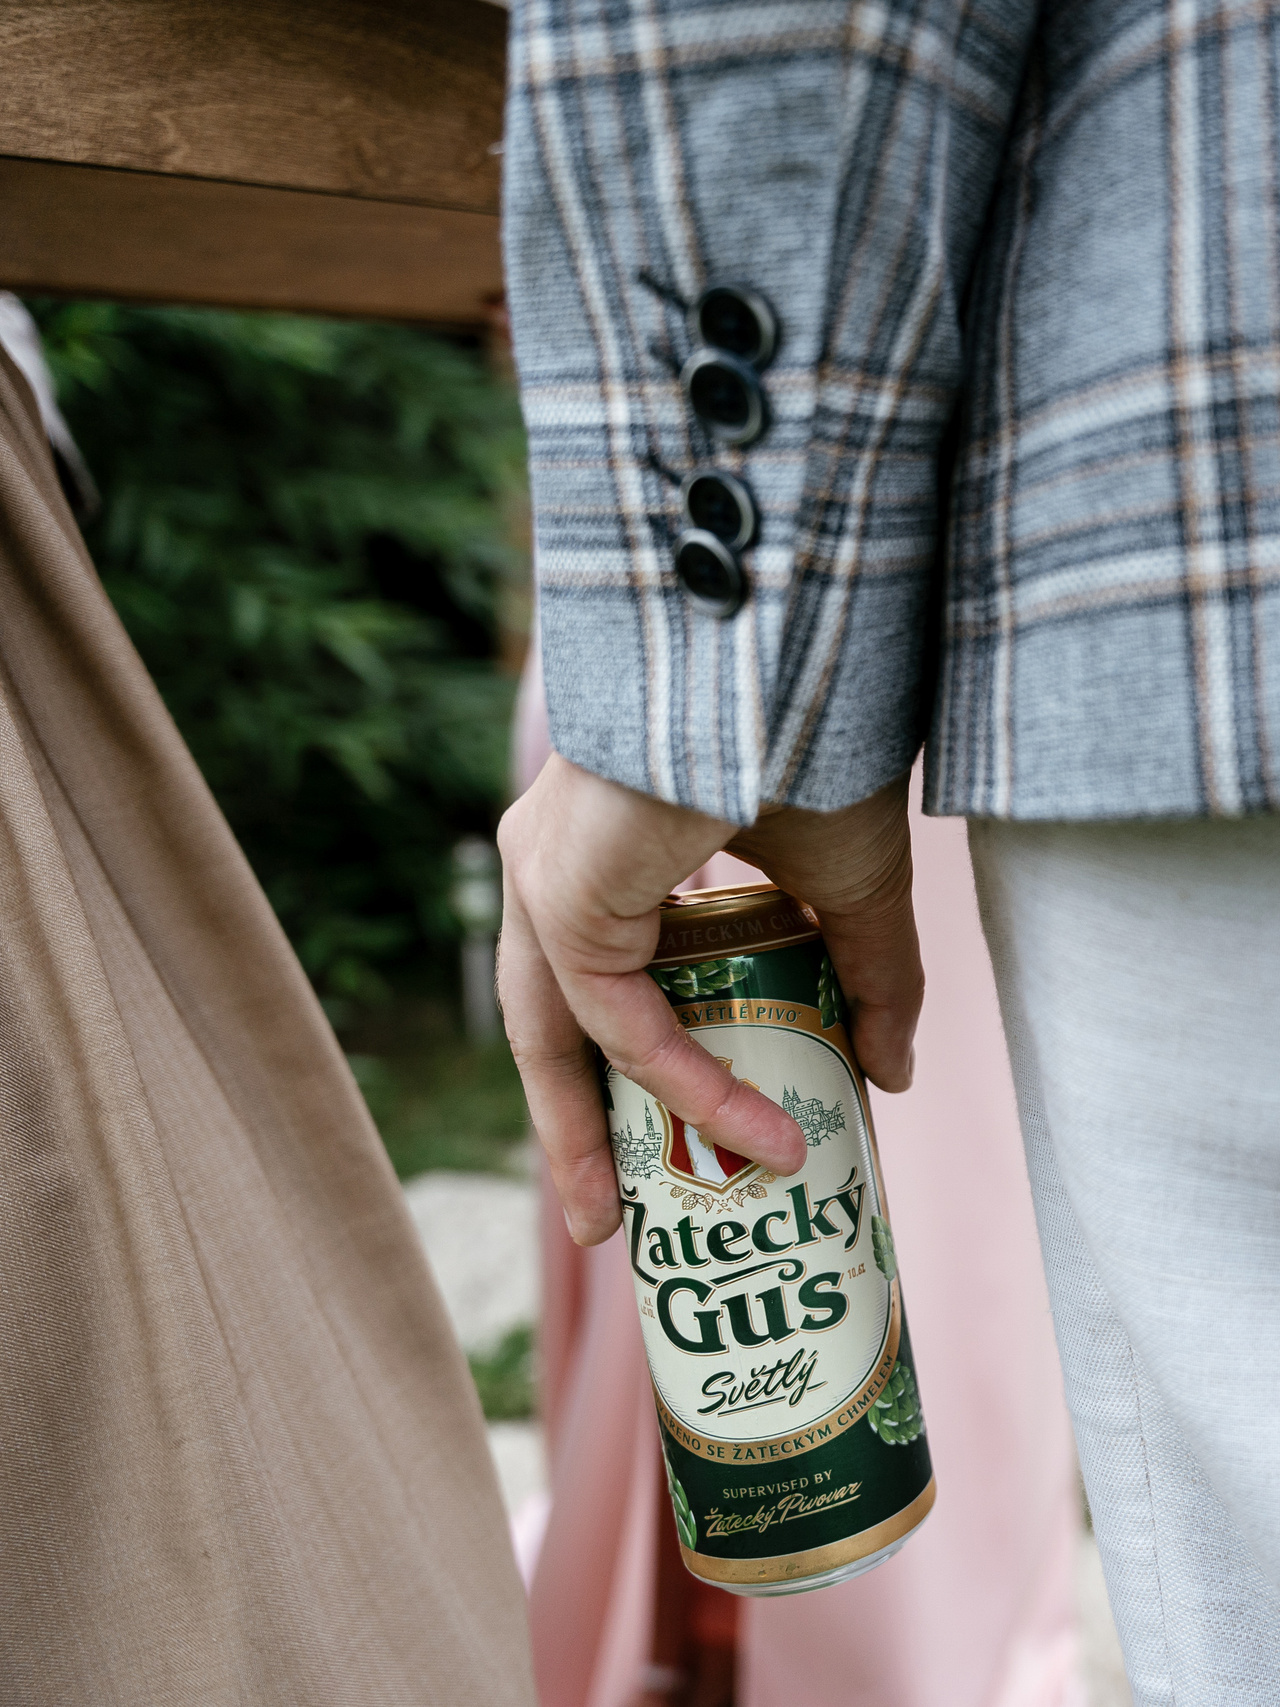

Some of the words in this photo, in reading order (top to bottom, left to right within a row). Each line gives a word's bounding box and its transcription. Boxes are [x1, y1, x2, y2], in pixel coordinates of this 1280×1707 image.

[756, 1006, 798, 1023] PIVO
[657, 1271, 850, 1357] Gus
[697, 1347, 829, 1416] Světlý
[706, 1444, 725, 1459] SE
[732, 1423, 833, 1460] ŽATECKÝM
[837, 1354, 893, 1426] CHMELEM
[704, 1505, 776, 1537] Žatecký
[777, 1480, 864, 1524] Pivovar
[722, 1477, 809, 1499] SUPERVISED
[814, 1468, 832, 1484] BY
